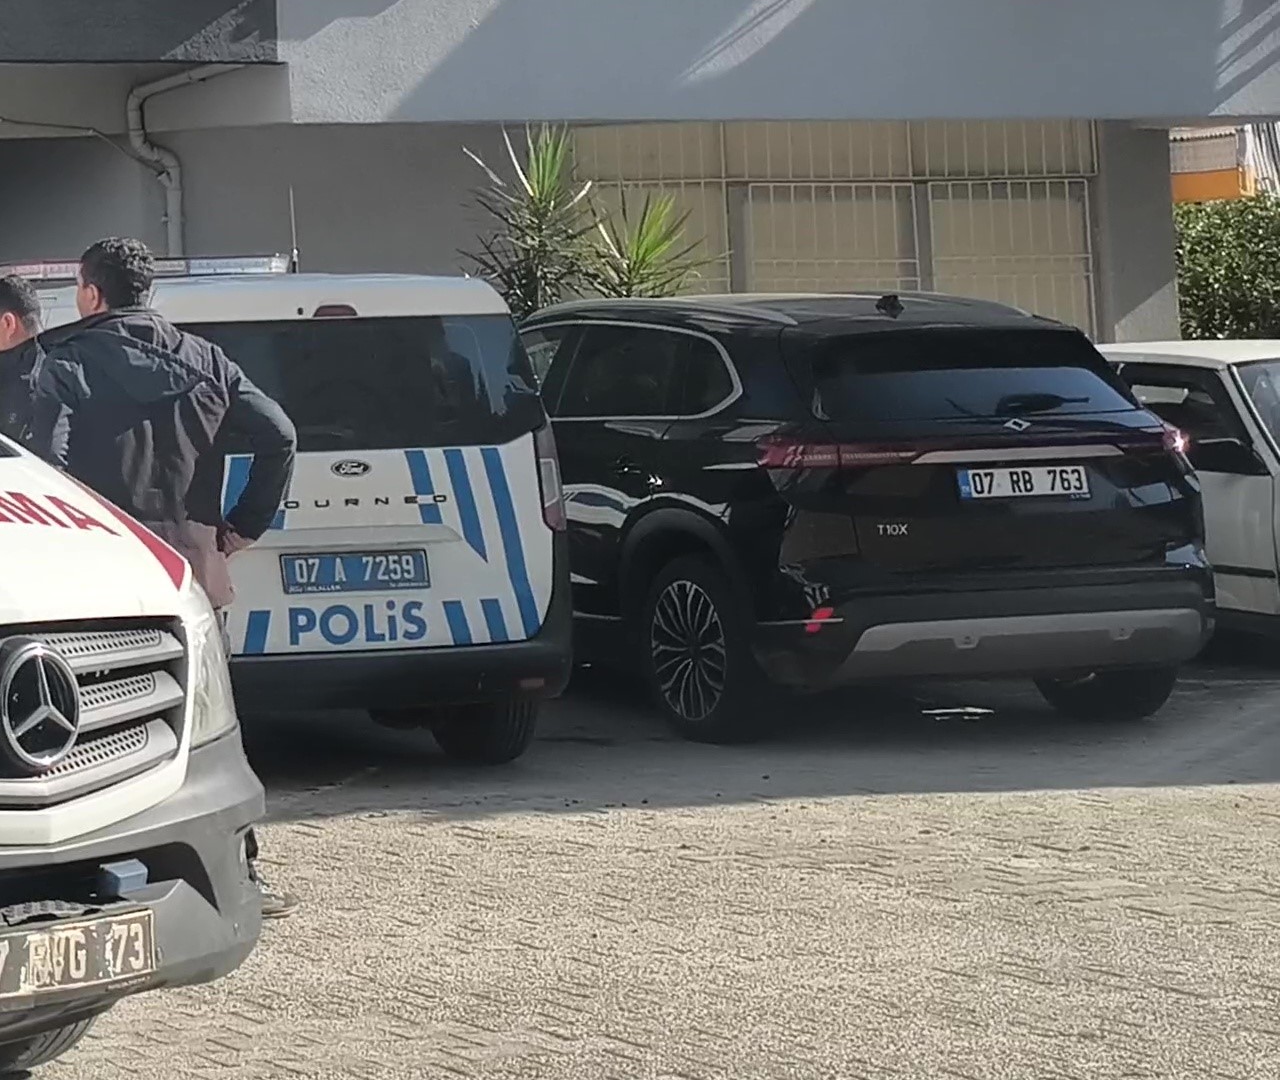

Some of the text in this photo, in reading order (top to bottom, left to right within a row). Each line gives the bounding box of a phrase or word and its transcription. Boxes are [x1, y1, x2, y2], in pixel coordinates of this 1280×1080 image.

[971, 468, 1084, 495] 07 RB 763
[283, 495, 448, 510] OURNEO
[877, 523, 909, 536] T10X
[295, 555, 415, 583] 07 A 7259
[112, 922, 145, 973] 73
